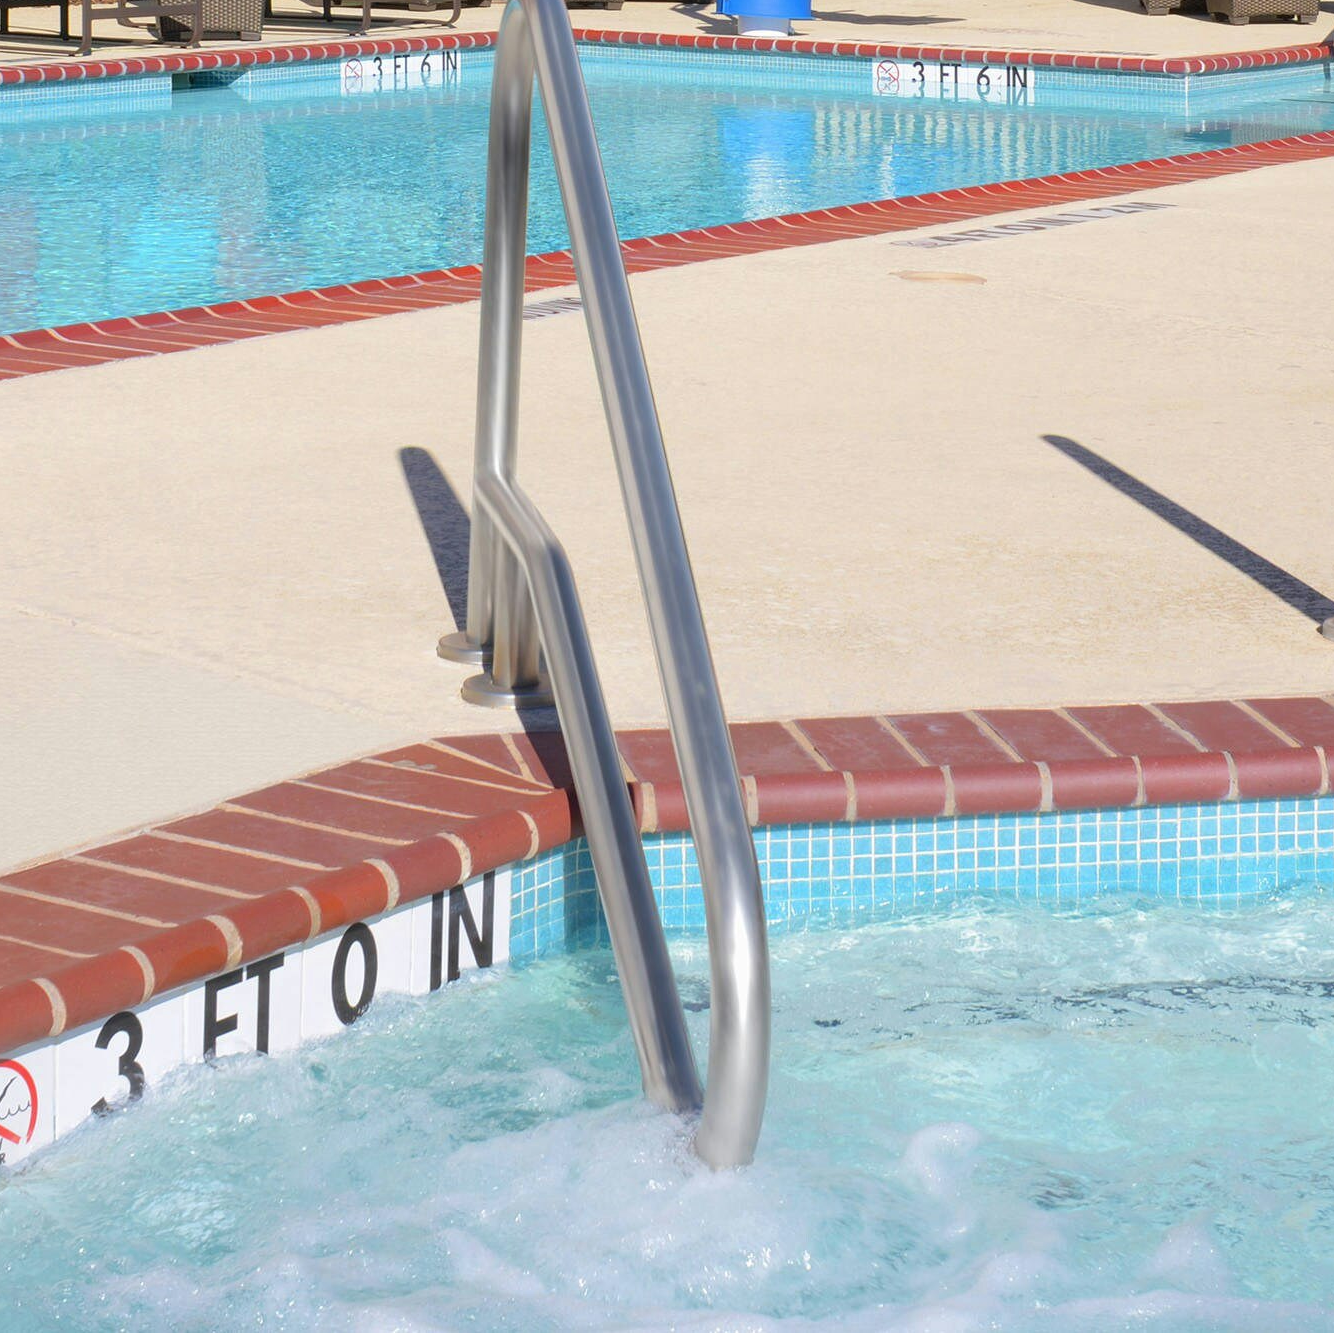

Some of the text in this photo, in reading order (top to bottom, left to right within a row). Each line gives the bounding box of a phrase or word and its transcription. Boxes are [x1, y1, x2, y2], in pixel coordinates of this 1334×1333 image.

[373, 51, 457, 76] 3 FT 6 IN
[912, 61, 1028, 88] 3 FT 6 IN
[91, 1011, 145, 1115] 3
[203, 952, 284, 1062] FT
[429, 870, 495, 992] IN
